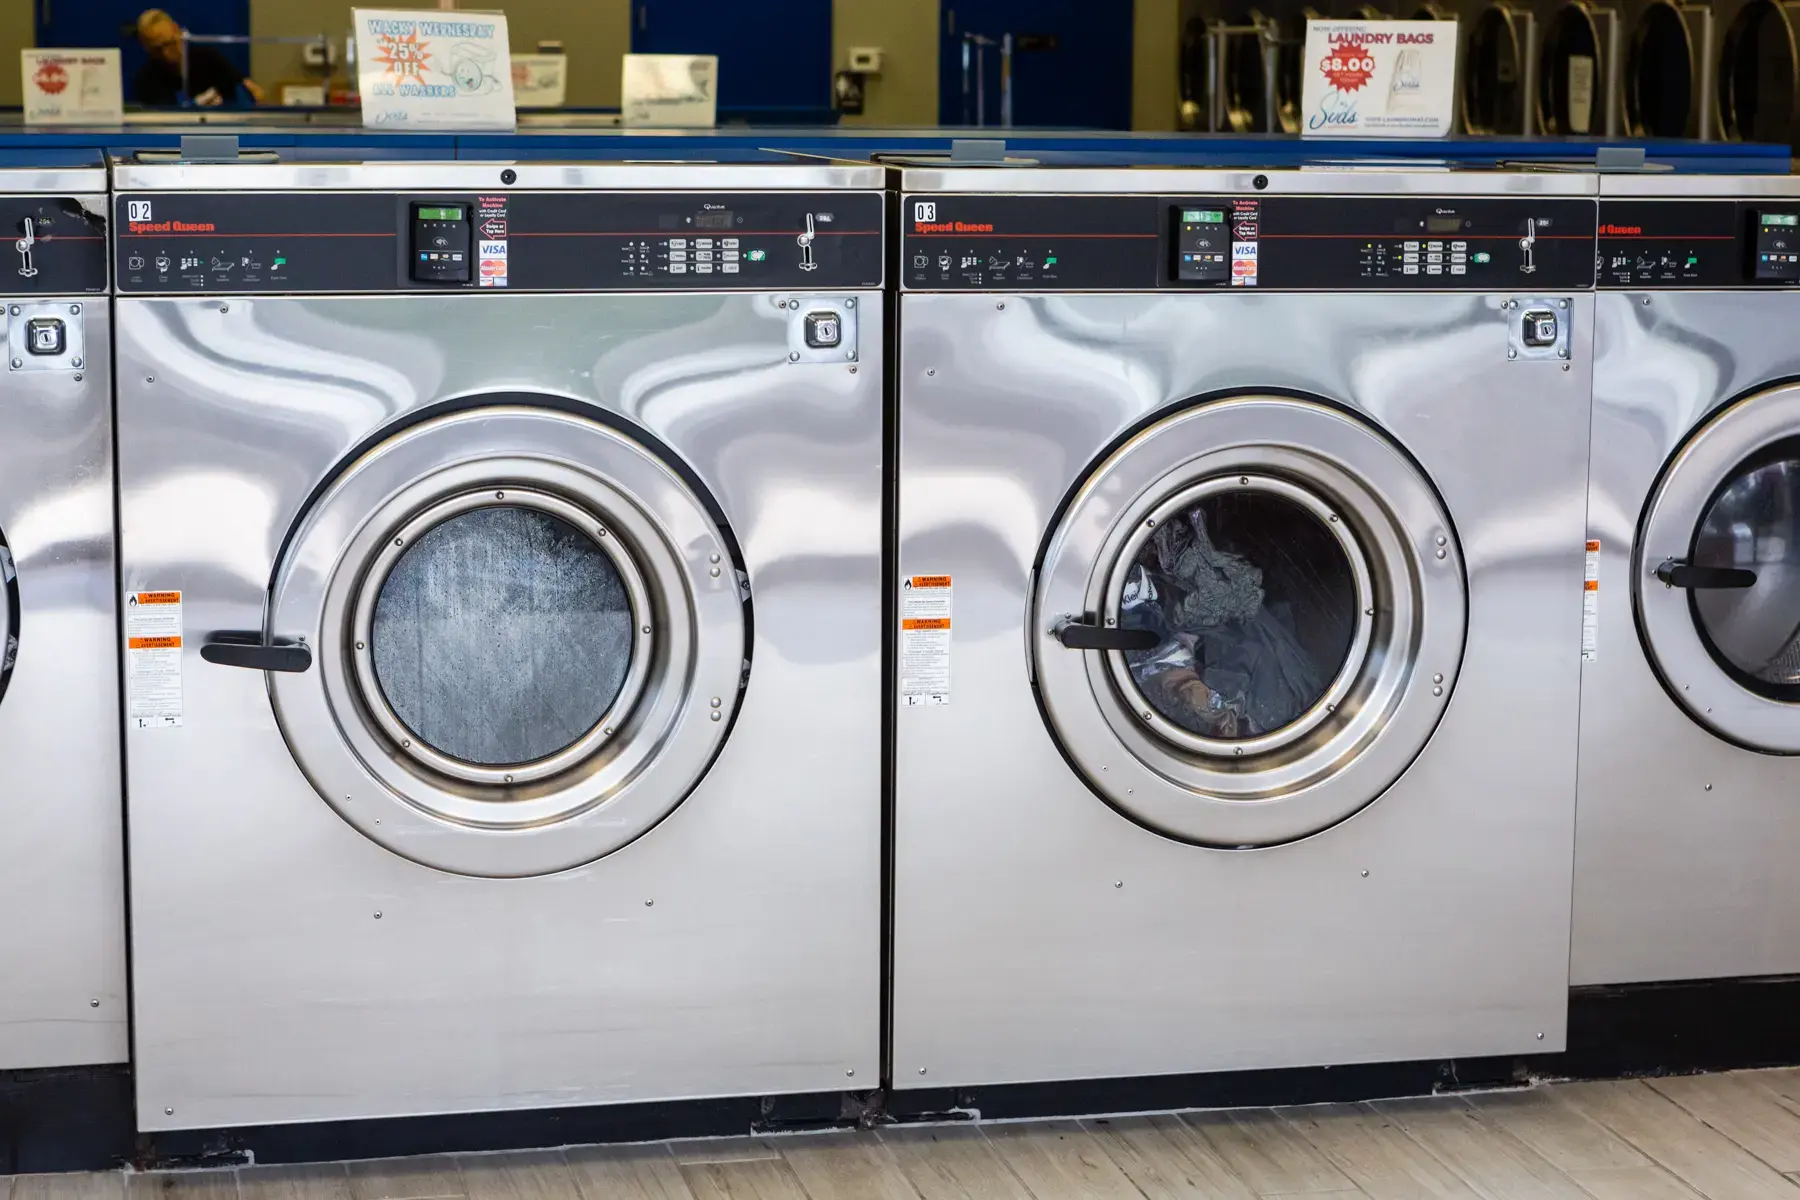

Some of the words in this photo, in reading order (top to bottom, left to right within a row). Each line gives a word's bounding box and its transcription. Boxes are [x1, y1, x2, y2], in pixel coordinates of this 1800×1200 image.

[368, 20, 416, 35] WACKY
[419, 22, 495, 38] WEDNESDAY
[1328, 33, 1393, 44] LAUNDRY
[1396, 33, 1434, 44] BAGS
[388, 42, 424, 60] 25%
[394, 61, 420, 77] OFF
[1321, 57, 1374, 72] $8.00
[372, 83, 395, 96] ALL
[399, 85, 456, 97] WASHERS
[1309, 91, 1358, 130] Suds
[130, 203, 150, 220] 02
[917, 204, 934, 220] 03
[129, 221, 171, 234] Speed
[173, 221, 215, 232] Queen
[915, 222, 953, 234] Speed
[955, 222, 993, 232] Queen
[1607, 224, 1641, 235] Queen
[482, 245, 506, 254] VISA
[1235, 246, 1256, 255] VISA
[1123, 588, 1141, 605] Klei
